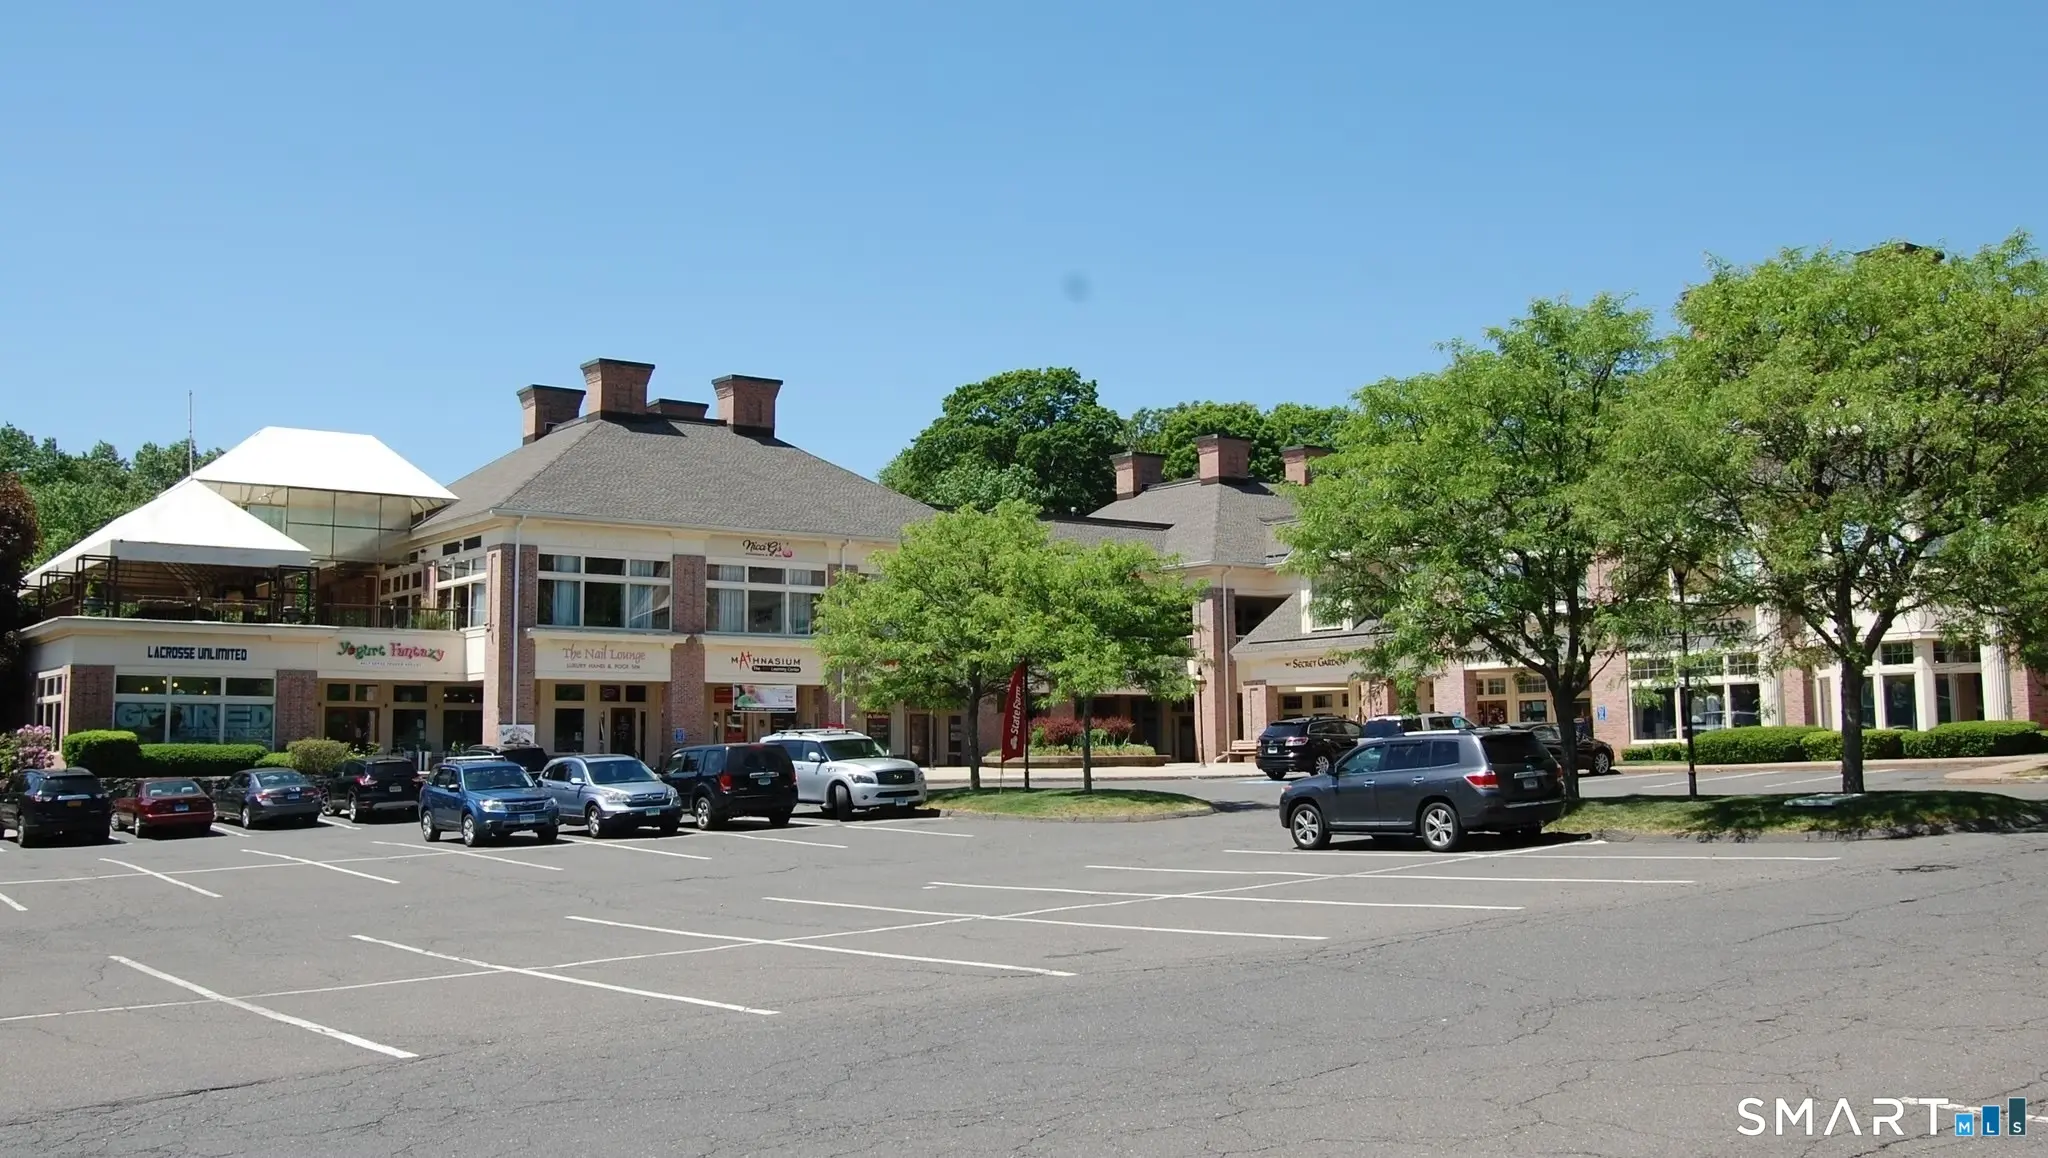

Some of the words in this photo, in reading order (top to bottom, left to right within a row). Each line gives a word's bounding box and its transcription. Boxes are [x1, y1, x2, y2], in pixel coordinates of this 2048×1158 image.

[147, 645, 196, 660] LACROSSE
[197, 647, 248, 661] UNLIMITED
[337, 641, 386, 660] Yogurt
[562, 643, 582, 661] The
[585, 644, 608, 660] Nail
[610, 649, 646, 664] Lounge
[731, 651, 801, 671] MATHNASIUM
